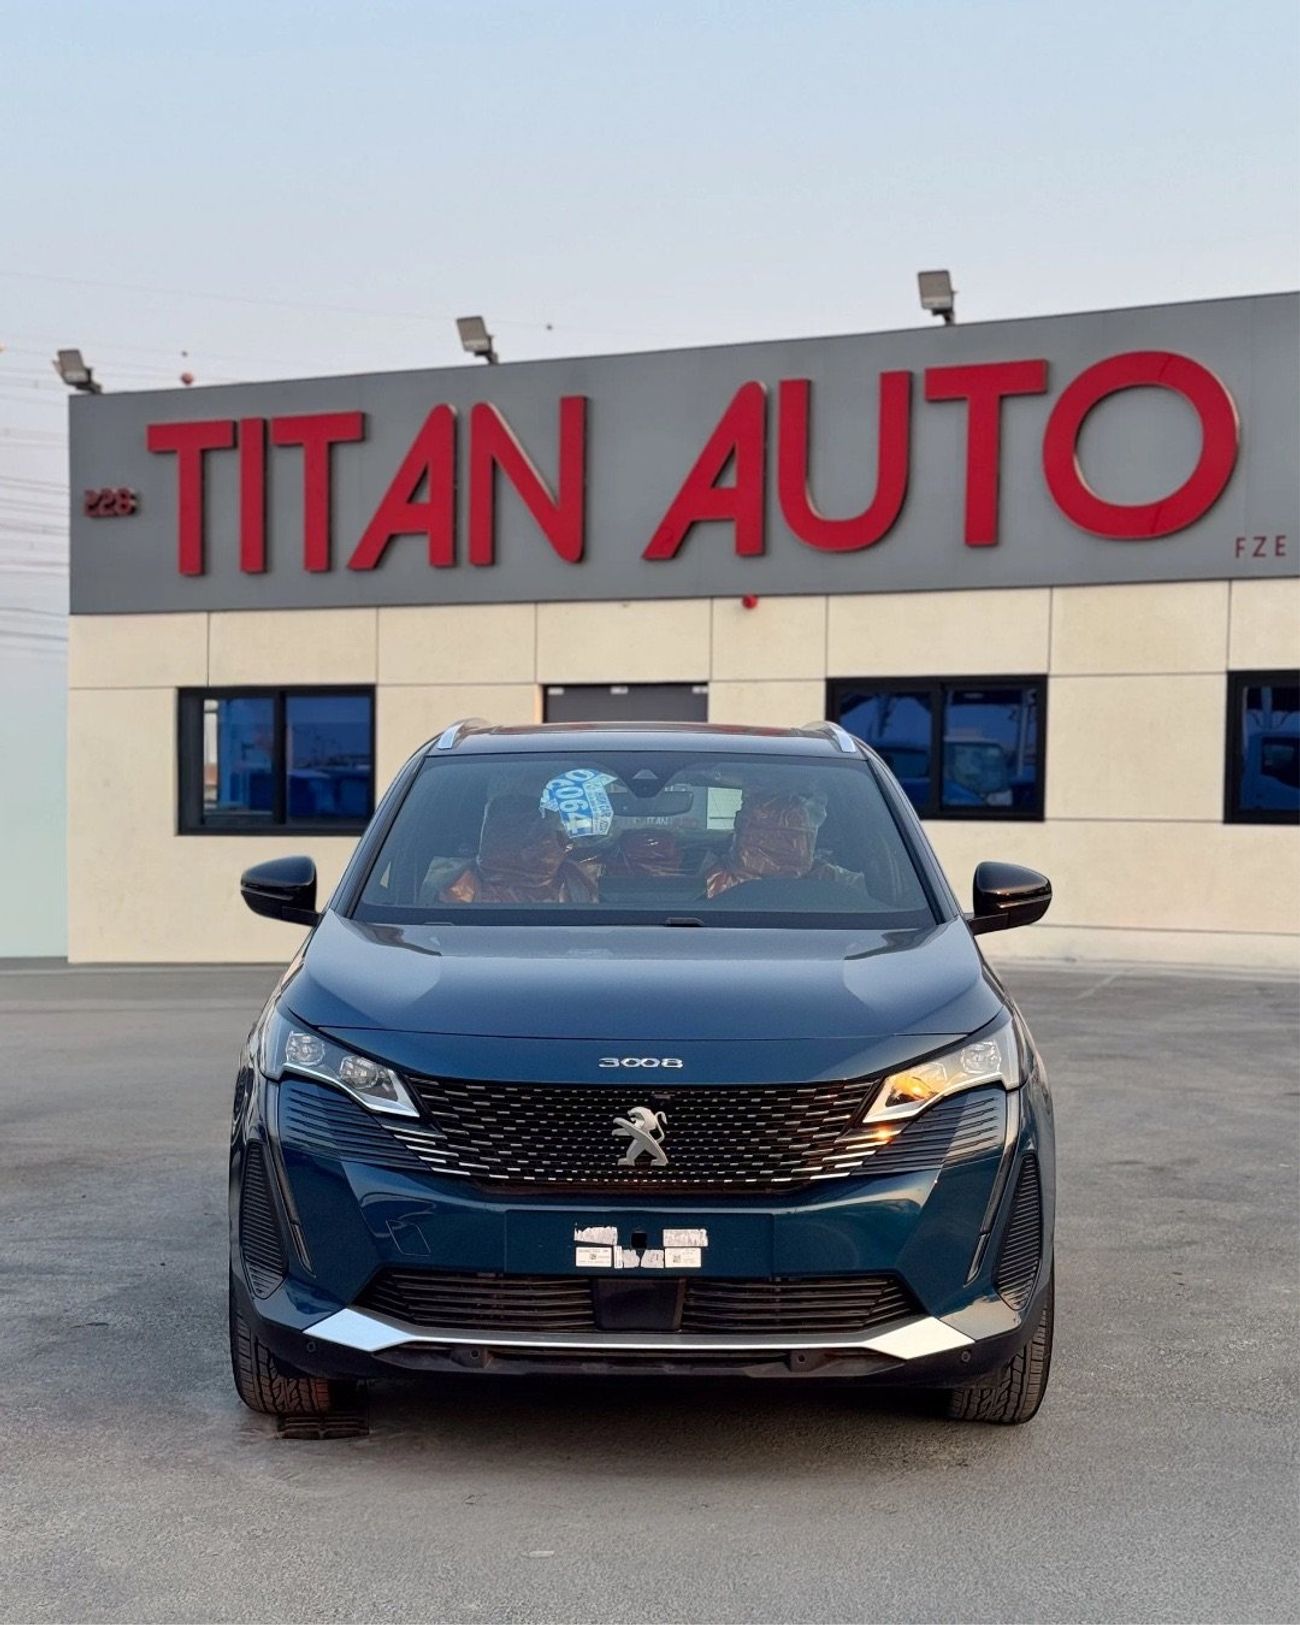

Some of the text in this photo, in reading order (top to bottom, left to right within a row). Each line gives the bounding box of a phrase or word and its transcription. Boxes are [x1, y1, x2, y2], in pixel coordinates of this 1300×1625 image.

[147, 350, 1239, 577] TITAN AUTO
[1235, 535, 1286, 559] FZE
[598, 1057, 683, 1068] 3008
